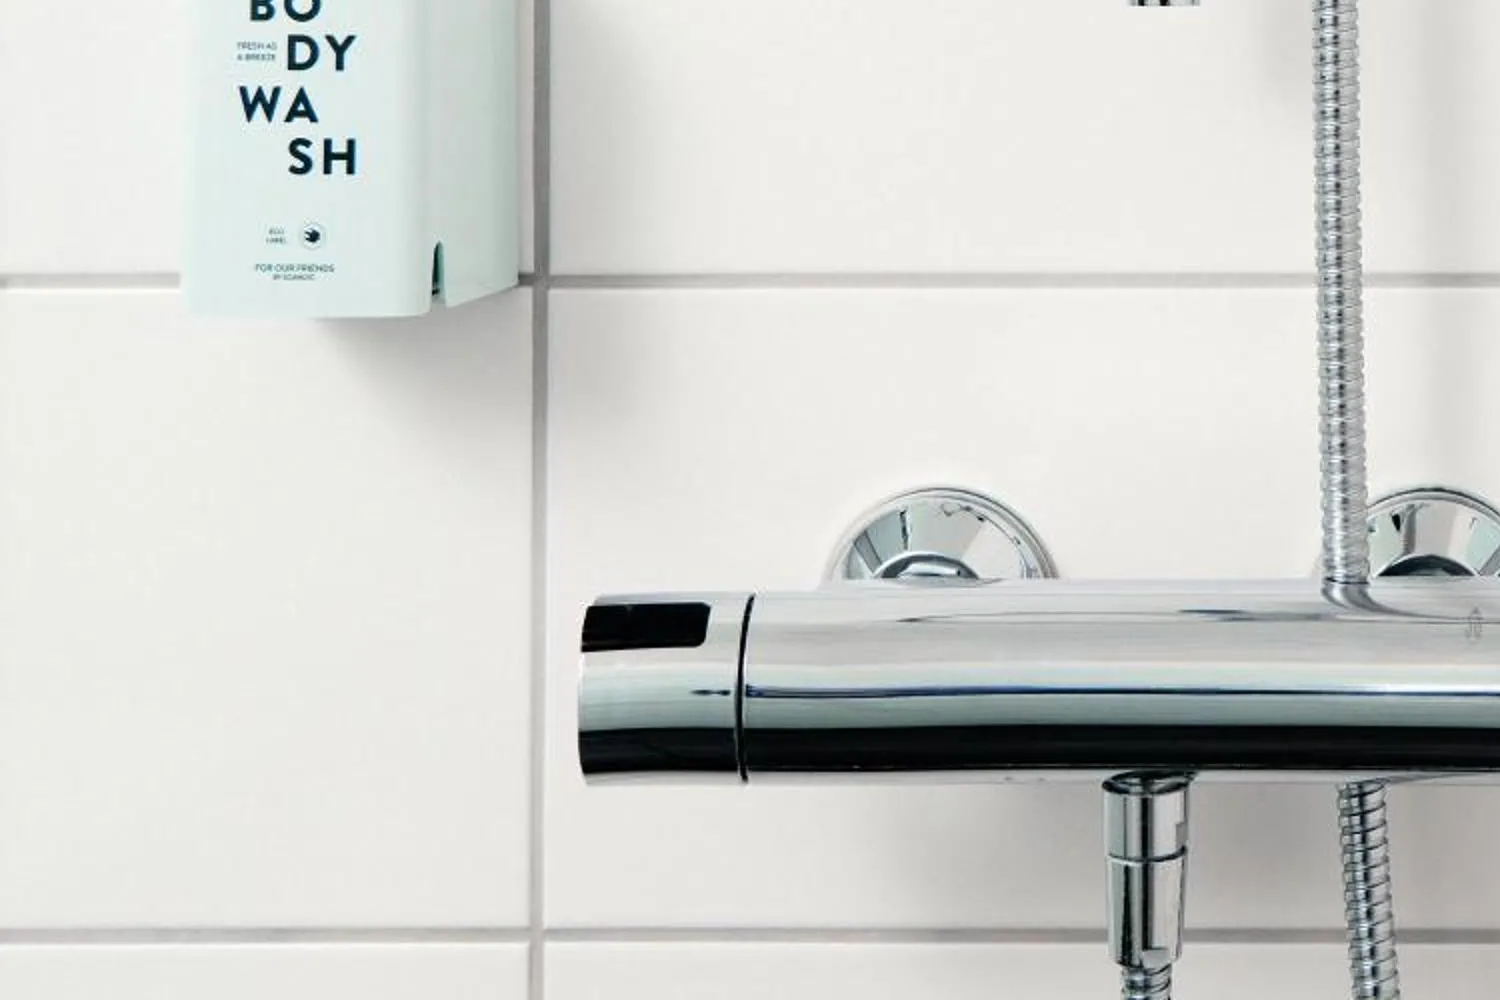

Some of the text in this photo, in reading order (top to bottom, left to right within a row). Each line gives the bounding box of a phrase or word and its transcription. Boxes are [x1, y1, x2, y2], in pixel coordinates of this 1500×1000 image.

[287, 34, 356, 72] DY
[239, 85, 319, 124] WA
[288, 137, 356, 176] SH
